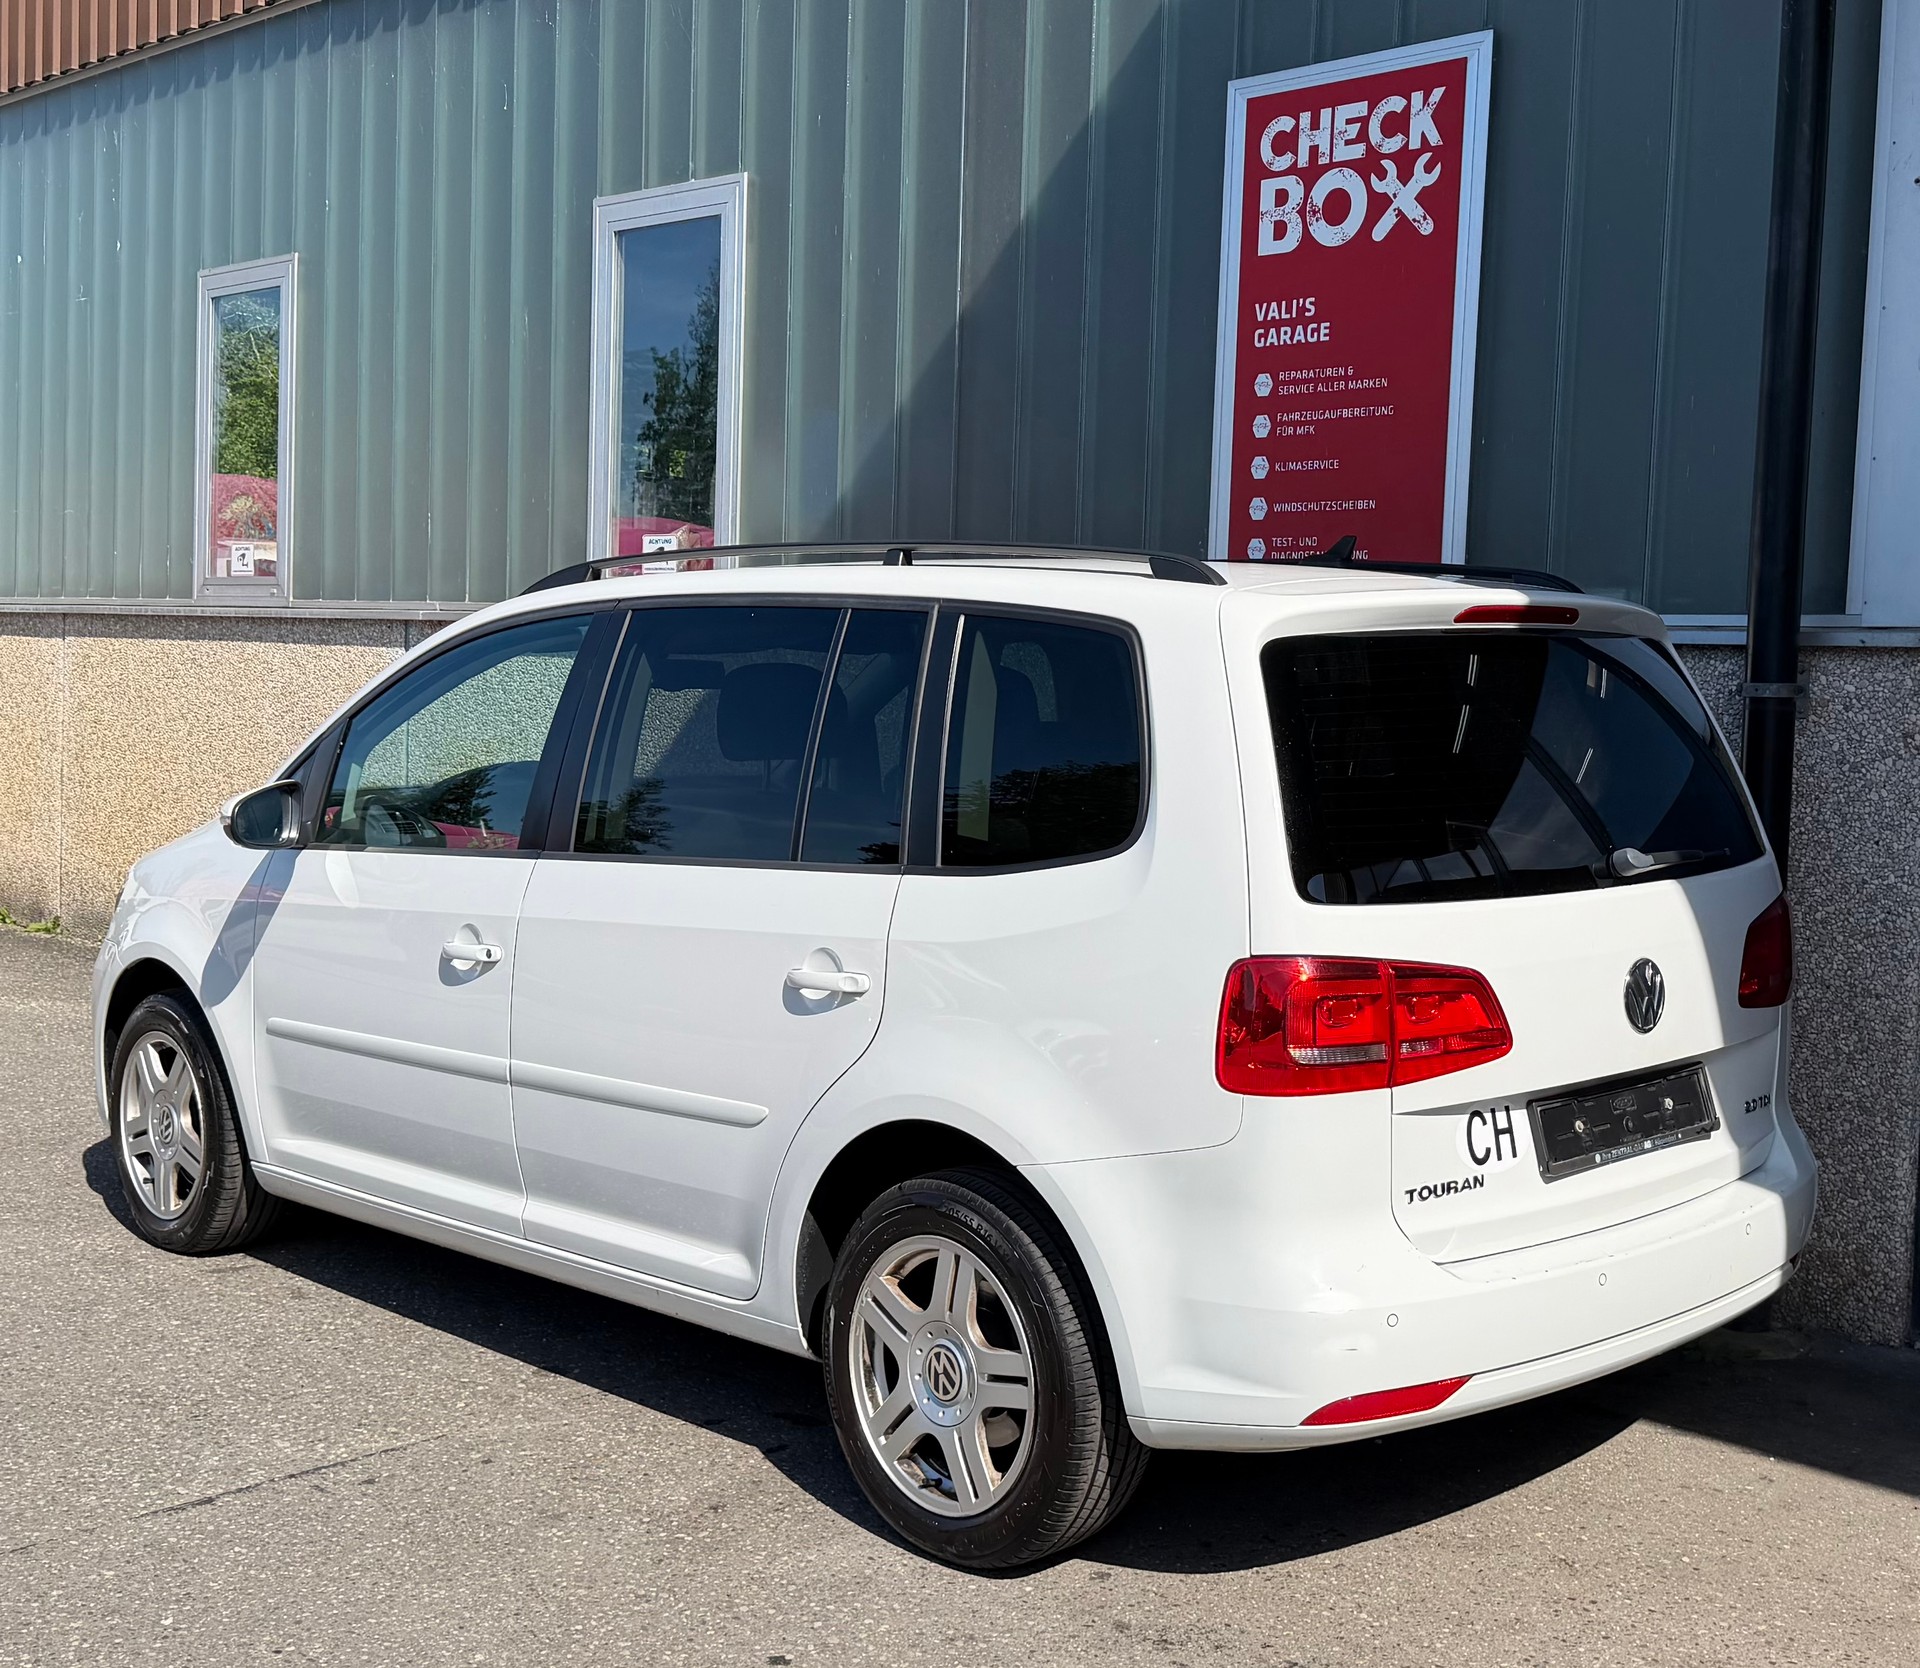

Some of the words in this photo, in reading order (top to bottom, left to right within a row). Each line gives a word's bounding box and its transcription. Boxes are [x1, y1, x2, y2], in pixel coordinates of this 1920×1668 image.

[1260, 86, 1446, 172] CHECK
[1254, 297, 1316, 322] VALI'S
[1253, 321, 1331, 348] GARAGE
[1278, 366, 1345, 381] REPARATUREN
[1347, 365, 1354, 376] &
[1278, 383, 1315, 396] SERVICE
[1316, 380, 1346, 392] ALLER
[1348, 377, 1388, 390] MARKEN
[1276, 405, 1394, 422] FAHRZEUGAUFBEREITUNG
[1276, 425, 1294, 437] FÜR
[1296, 425, 1315, 436] MFK
[1274, 459, 1340, 472] KLIMASERVICE
[1273, 499, 1376, 512] WINDSCHUTZSCHEIBEN
[1271, 537, 1296, 547] TEST-
[1299, 536, 1318, 547] UND
[1466, 1105, 1517, 1166] CH
[1404, 1174, 1484, 1204] TOURAN
